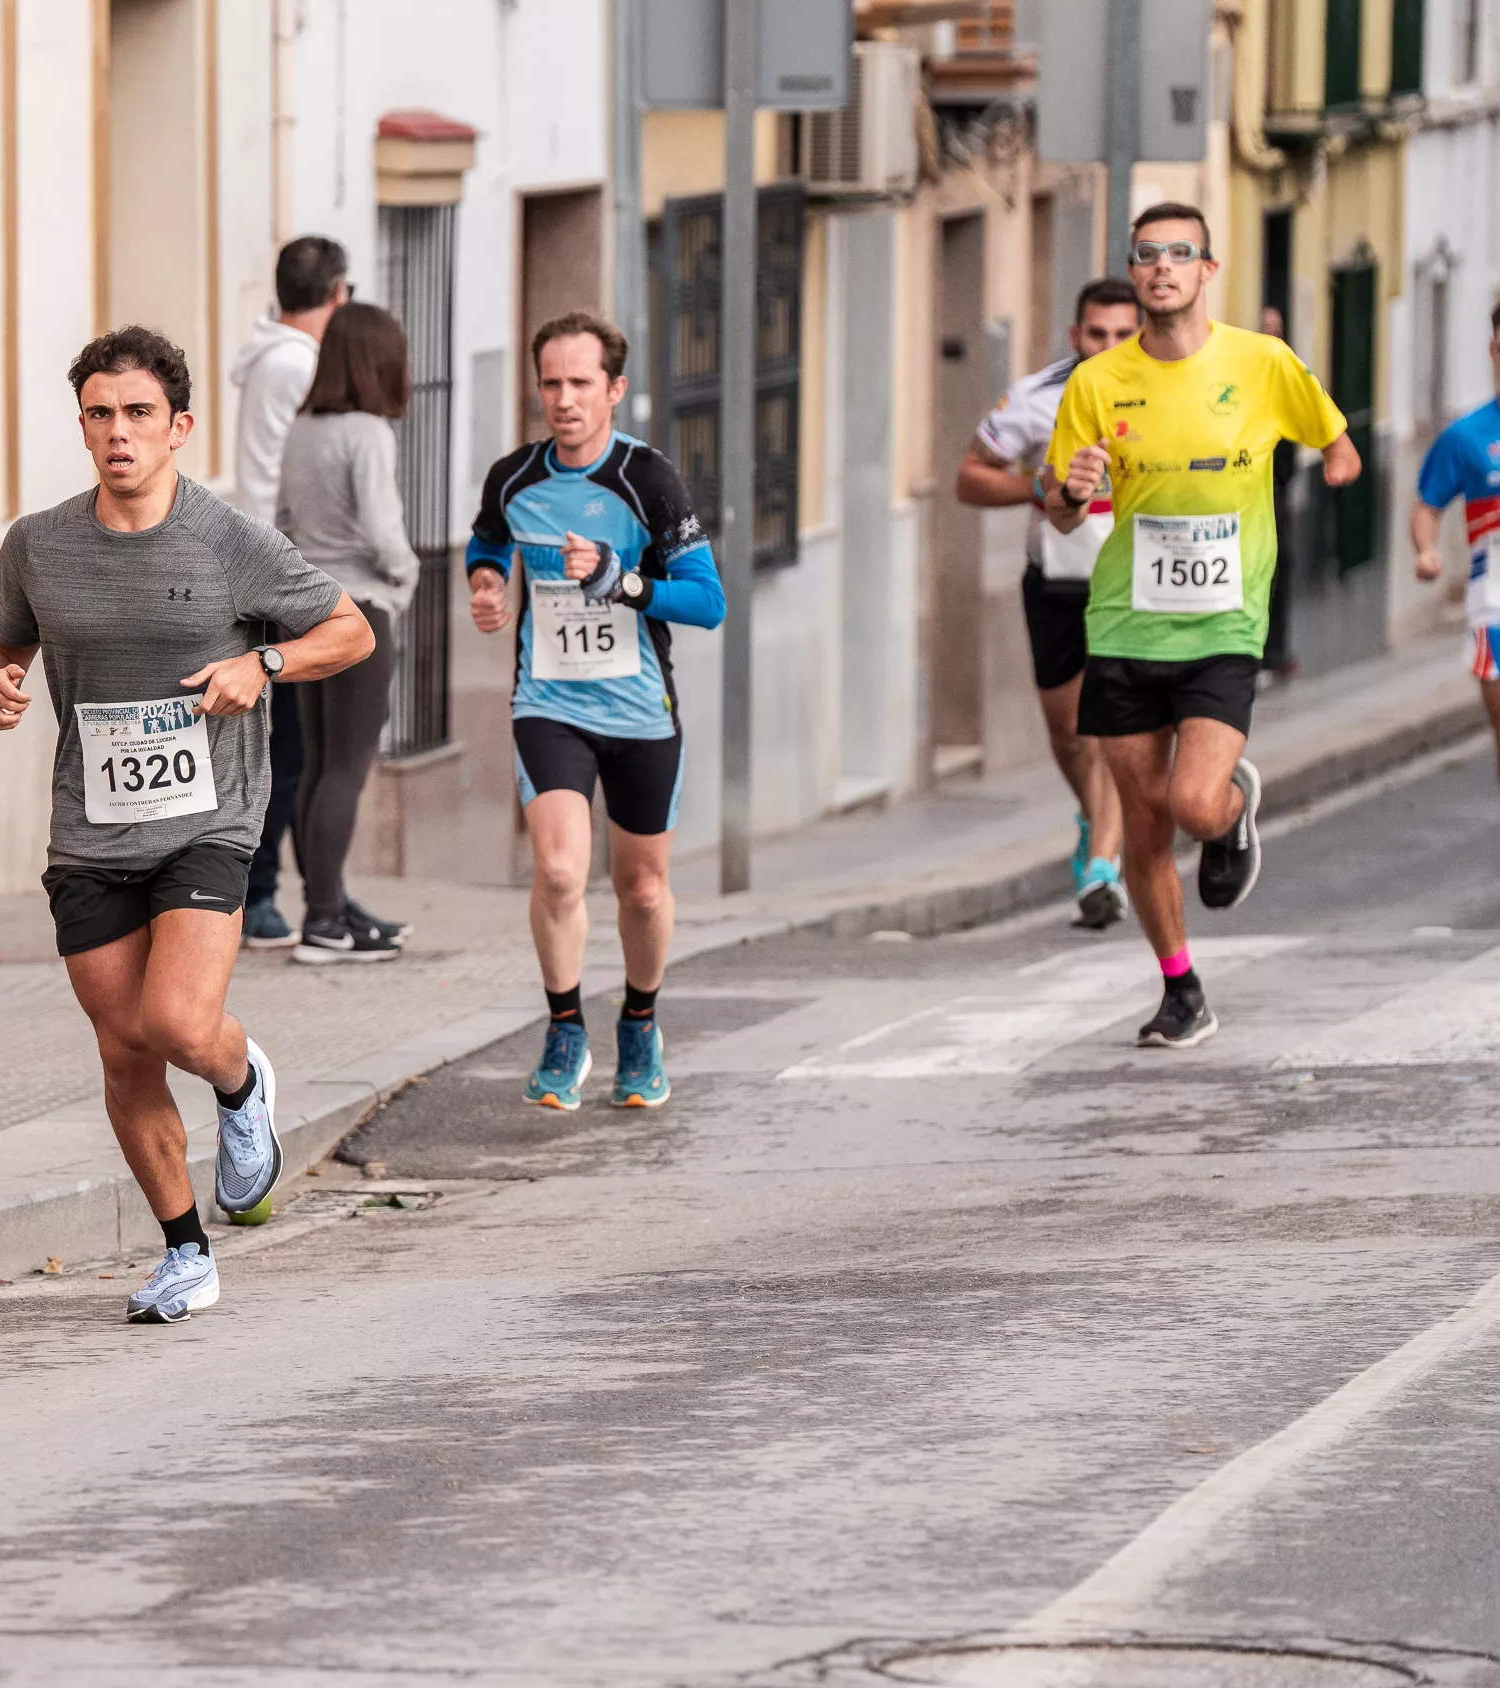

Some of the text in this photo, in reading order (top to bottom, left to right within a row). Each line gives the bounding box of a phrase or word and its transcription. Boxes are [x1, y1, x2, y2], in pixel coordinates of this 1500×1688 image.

[1151, 556, 1230, 587] 1502
[556, 623, 615, 654] 115
[100, 750, 196, 792] 1320
